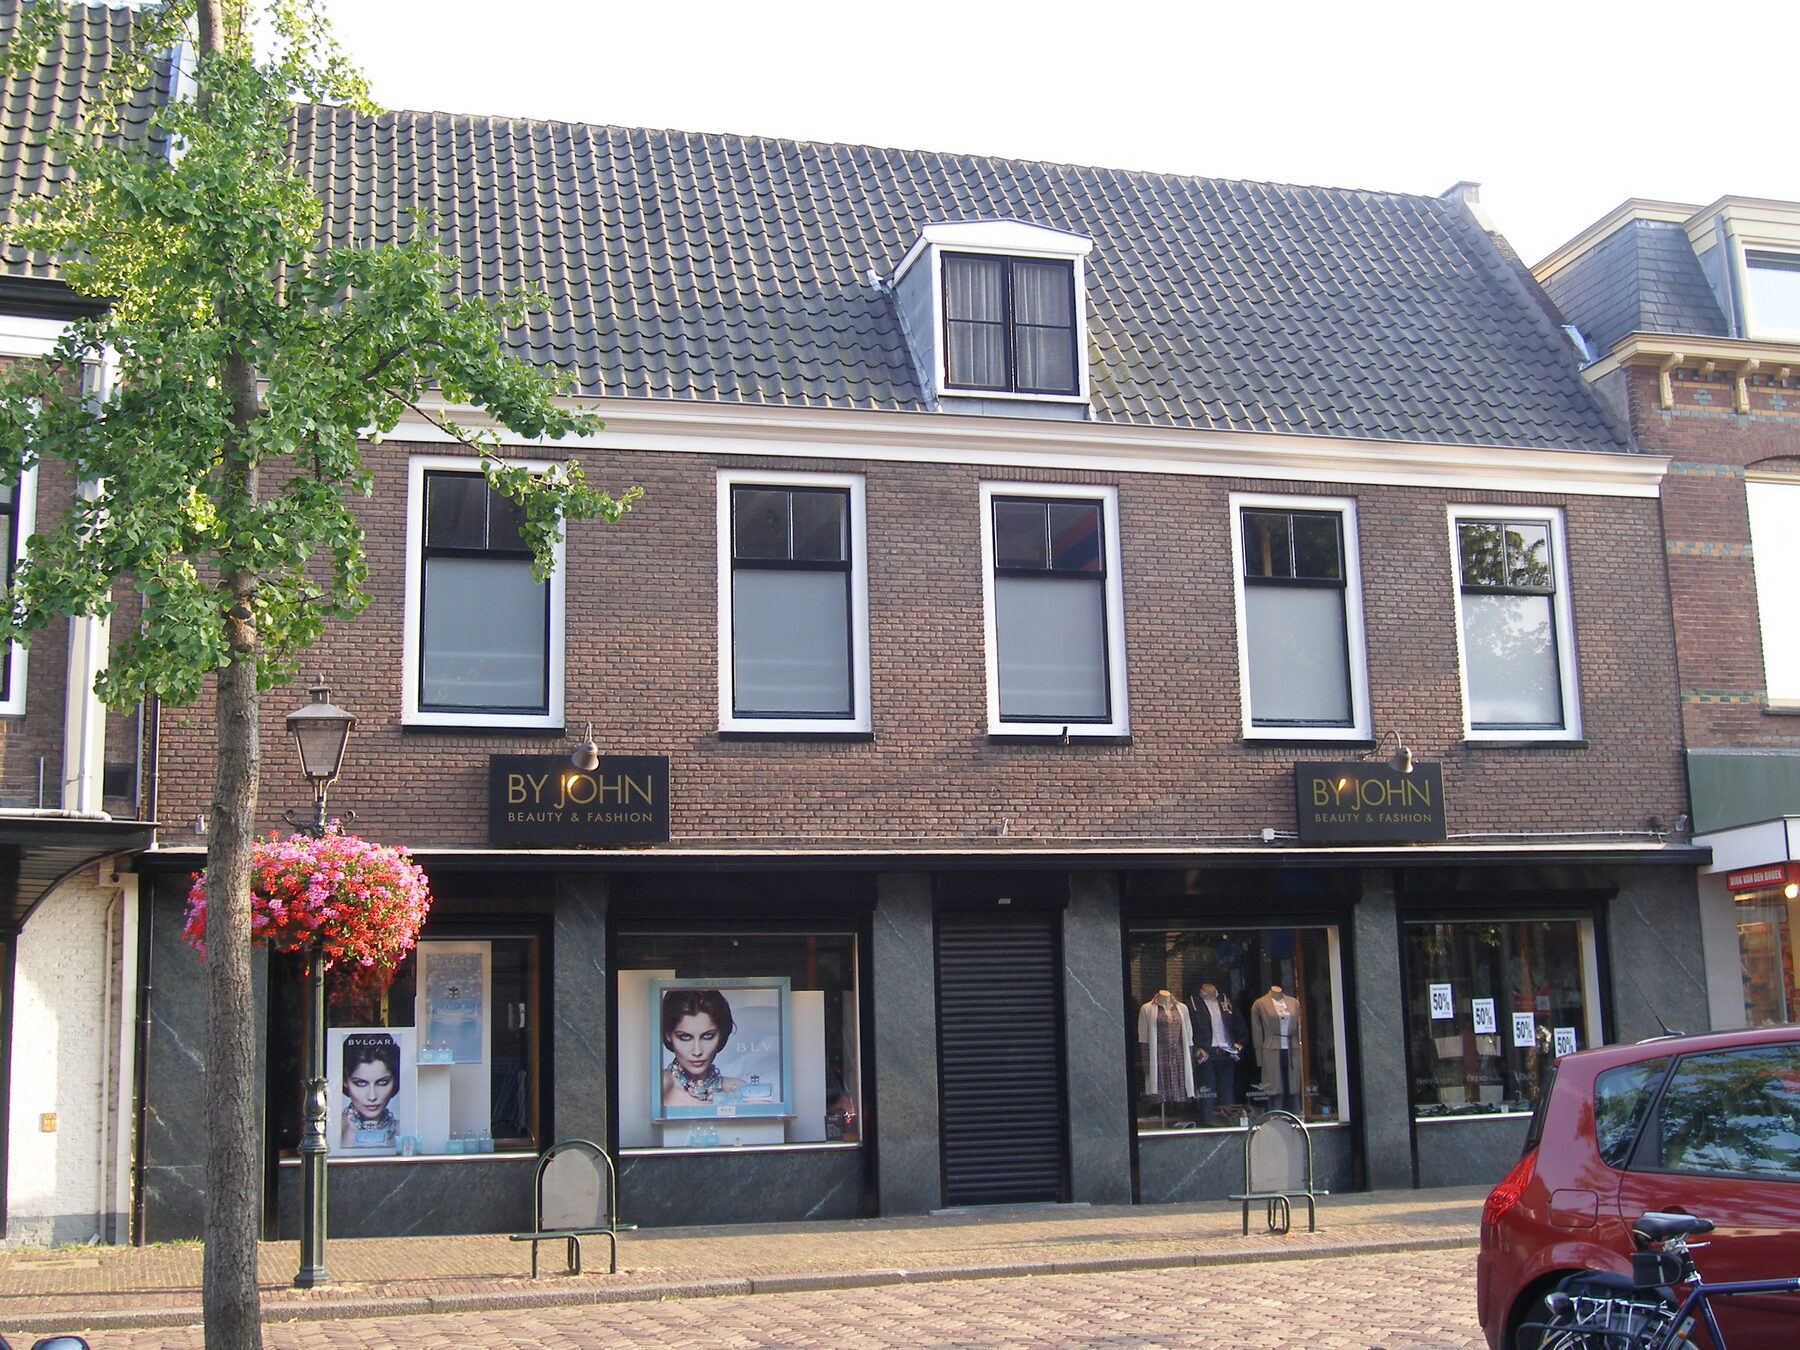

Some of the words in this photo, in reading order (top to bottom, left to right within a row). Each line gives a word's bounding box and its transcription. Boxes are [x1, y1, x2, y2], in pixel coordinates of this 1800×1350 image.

[508, 773, 549, 804] BY
[553, 773, 652, 809] JOHN
[1312, 778, 1346, 806] BY
[1351, 779, 1431, 811] JOHN
[508, 812, 562, 822] BEAUTY
[570, 812, 580, 822] &
[587, 812, 653, 822] FASHION
[1315, 813, 1360, 823] BEAUTY
[1366, 813, 1374, 823] &
[1379, 813, 1432, 823] FASHION
[1432, 992, 1450, 1011] 50%
[1475, 1007, 1493, 1025] 50%
[1516, 1020, 1533, 1039] 50%
[736, 1042, 772, 1052] BLV
[1557, 1035, 1574, 1054] 50%
